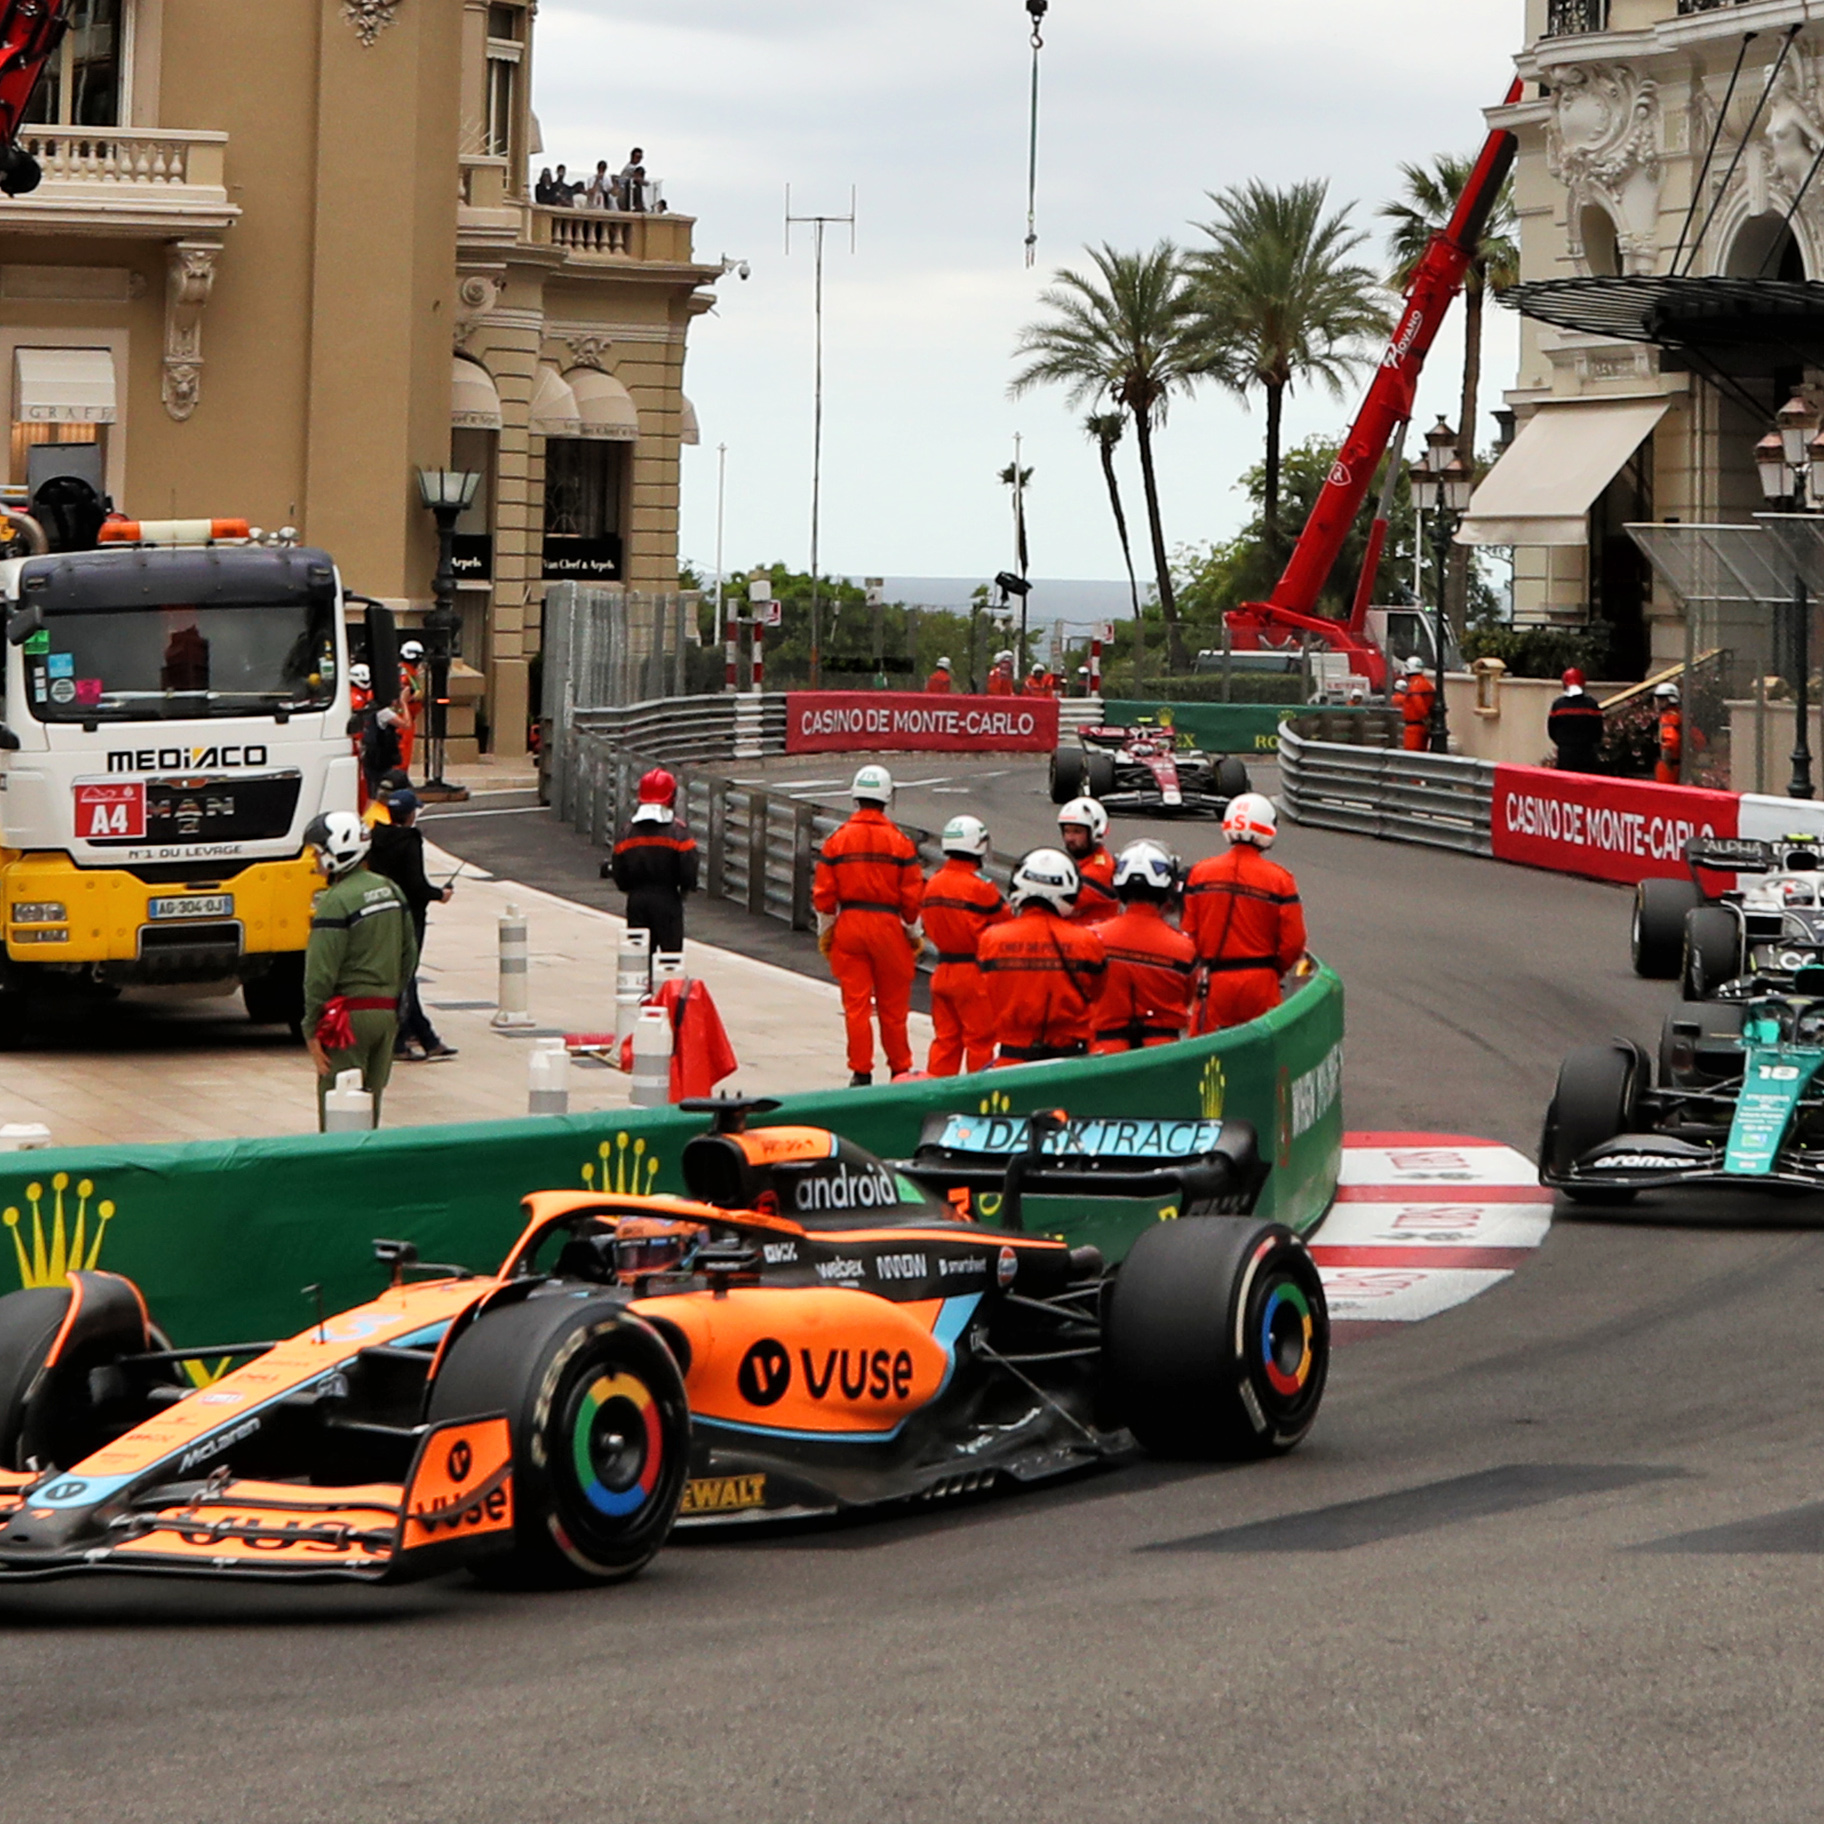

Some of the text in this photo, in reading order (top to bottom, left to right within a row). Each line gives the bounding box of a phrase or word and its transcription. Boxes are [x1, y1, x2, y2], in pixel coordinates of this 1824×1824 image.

[30, 405, 114, 422] GRAFF
[801, 708, 1035, 736] CASINO DE MONTE-CARLO
[89, 803, 129, 836] A4
[147, 796, 236, 819] MAN
[1505, 792, 1561, 840] CASINO
[1561, 800, 1583, 845] DE
[1234, 815, 1247, 831] S
[159, 847, 181, 859] DU
[185, 845, 243, 858] LEVAGE
[1758, 1065, 1800, 1081] 18
[795, 1162, 898, 1211] android
[815, 1255, 866, 1279] webex
[178, 1416, 263, 1475] McLaren
